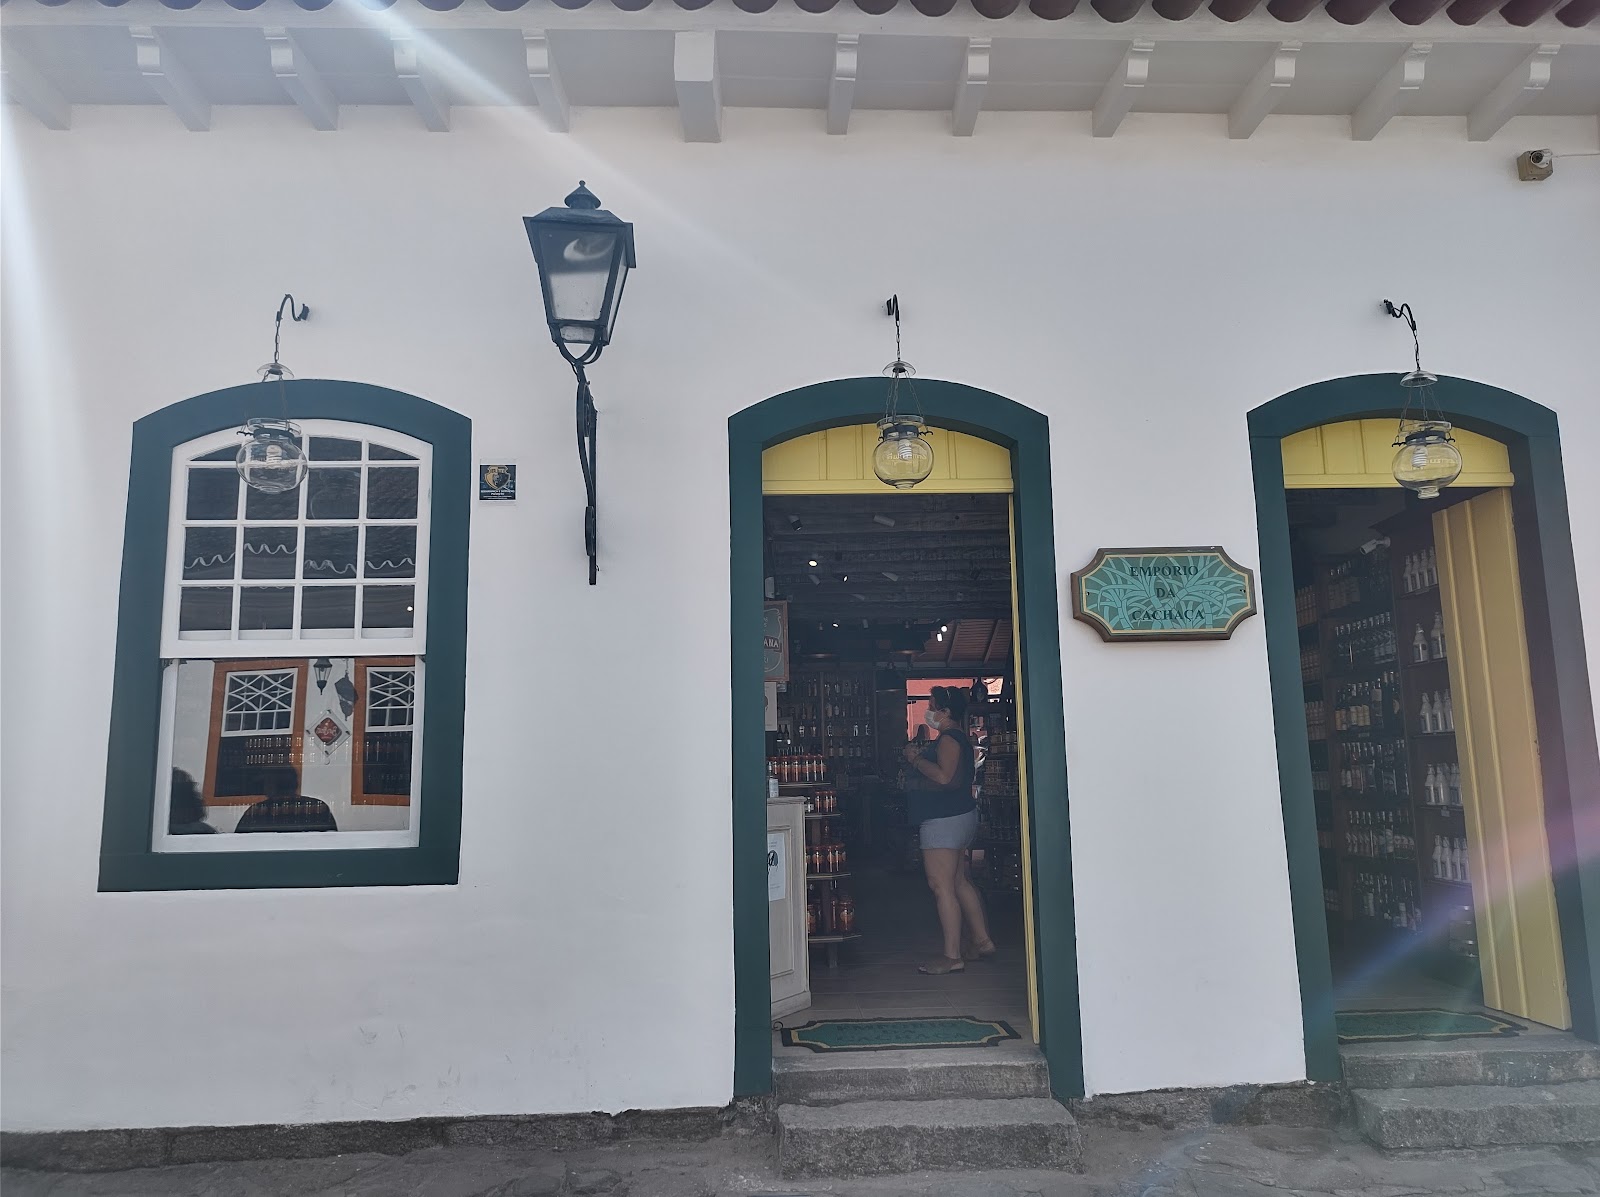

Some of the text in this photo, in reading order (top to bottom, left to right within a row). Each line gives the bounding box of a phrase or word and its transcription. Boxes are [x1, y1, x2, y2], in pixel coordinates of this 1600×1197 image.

[1130, 563, 1199, 577] EMPÓRIO
[1156, 588, 1176, 598] DA
[1132, 609, 1205, 621] CACHAÇA
